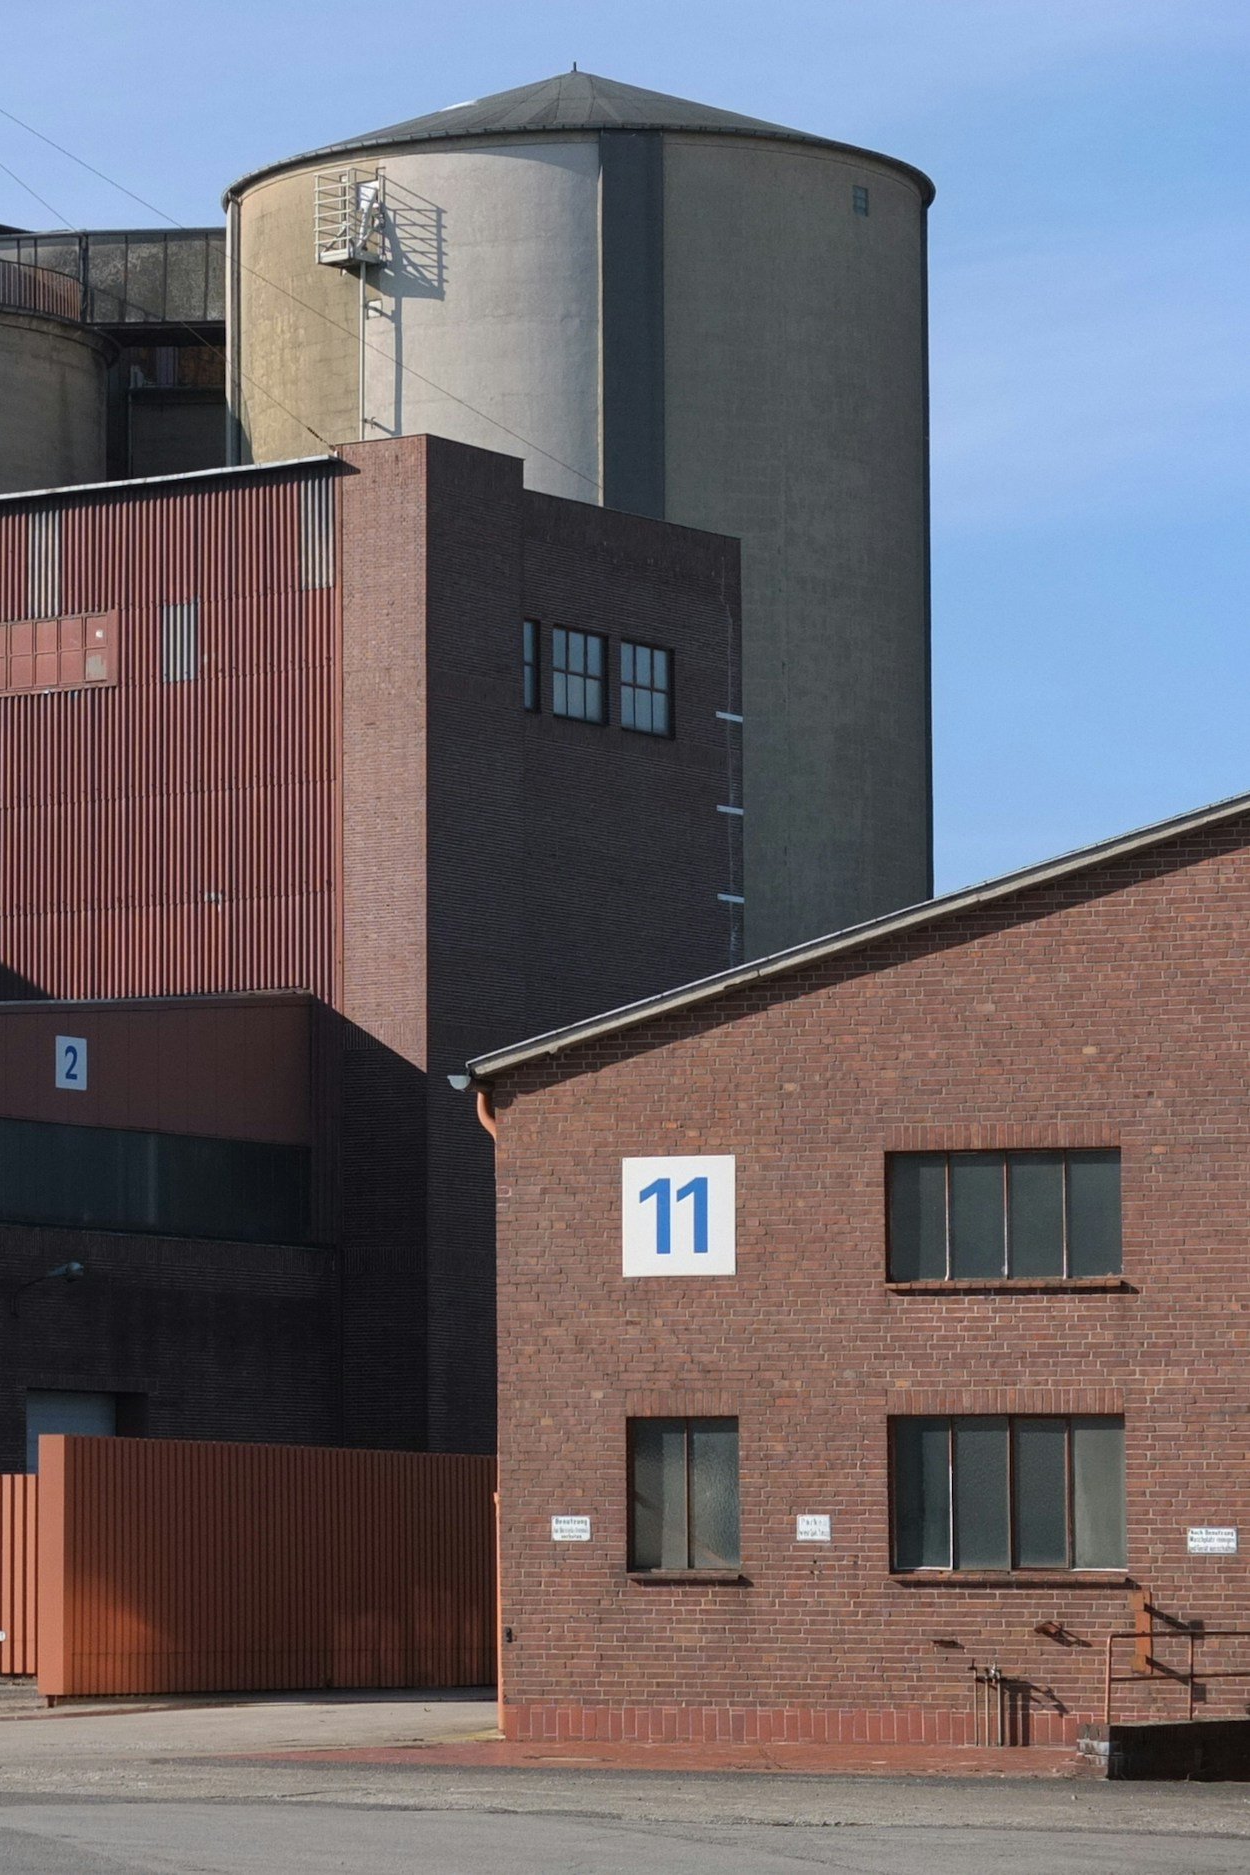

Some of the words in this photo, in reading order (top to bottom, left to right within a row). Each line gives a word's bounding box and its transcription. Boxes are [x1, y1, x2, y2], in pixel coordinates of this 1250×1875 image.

[64, 1045, 78, 1080] 2
[639, 1177, 708, 1254] 11
[555, 1518, 588, 1526] Benutzung
